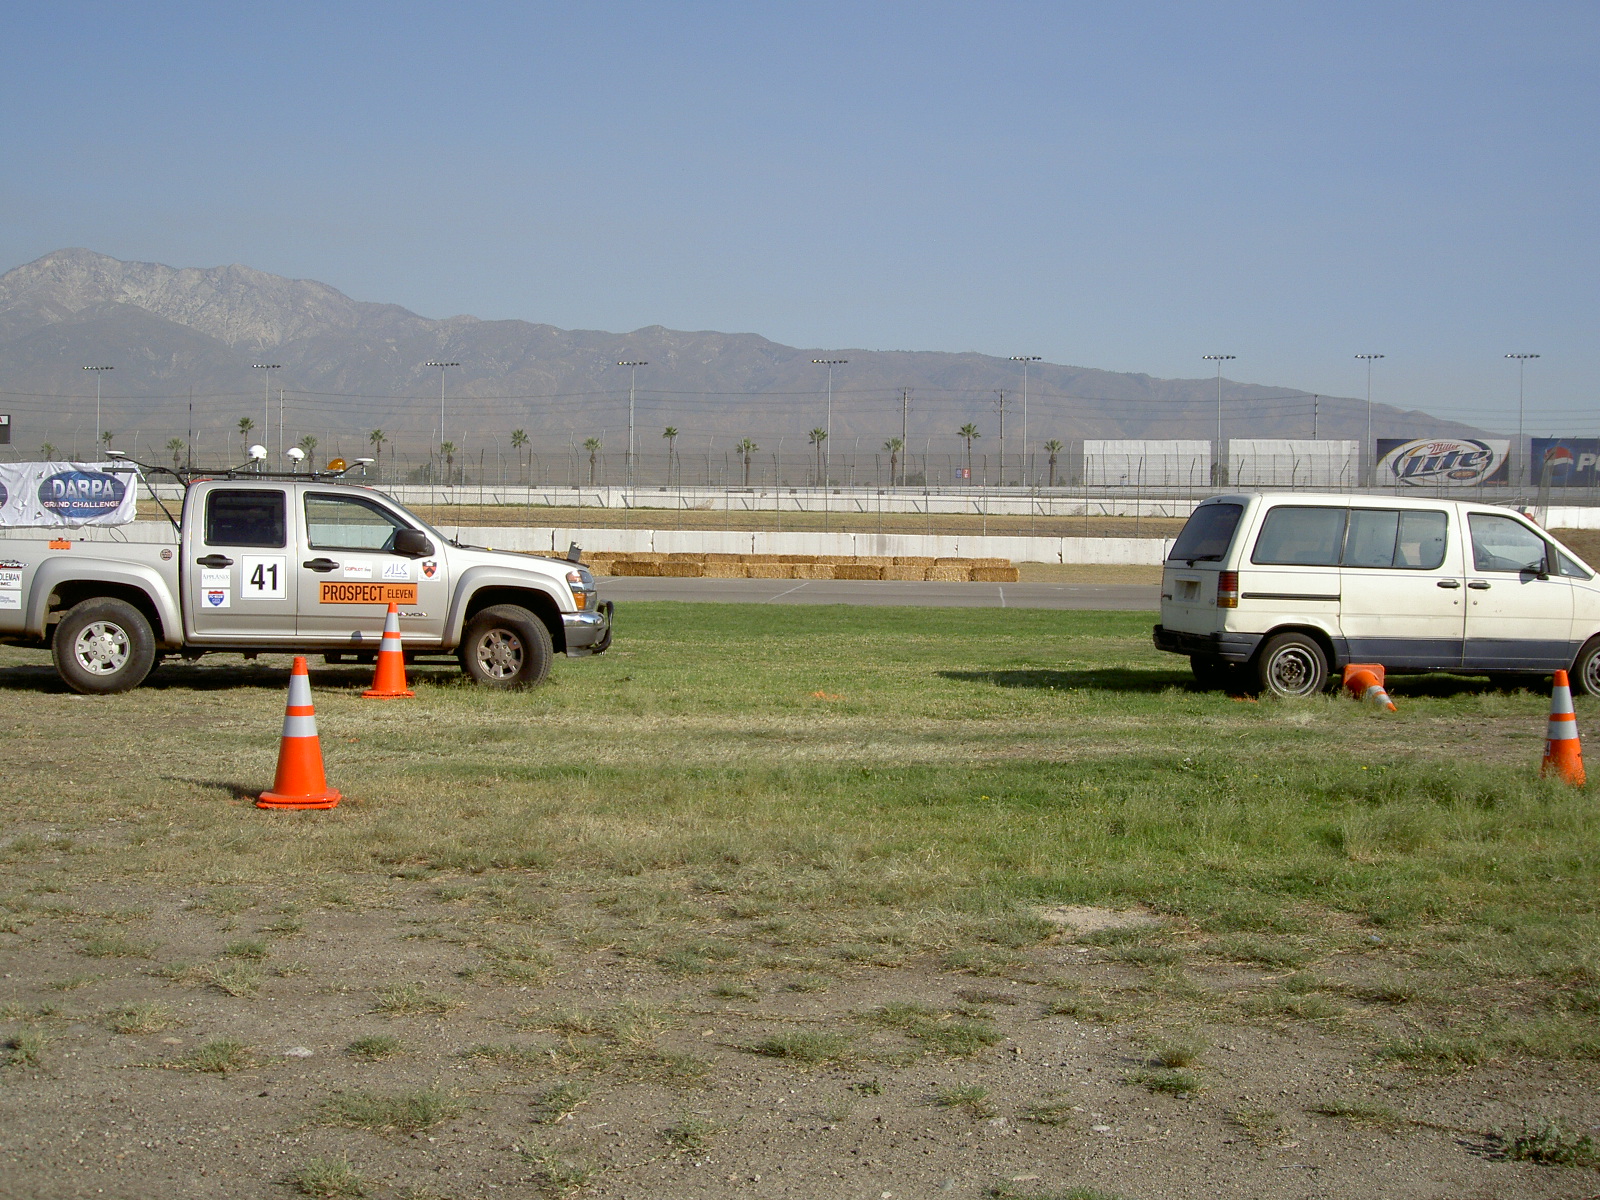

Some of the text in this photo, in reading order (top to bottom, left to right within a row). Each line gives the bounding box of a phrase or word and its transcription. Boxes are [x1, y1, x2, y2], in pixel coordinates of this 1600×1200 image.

[1427, 442, 1461, 455] Miller
[52, 479, 115, 499] DARPA
[72, 500, 120, 508] CHALLENGE
[250, 563, 278, 591] 41
[322, 585, 413, 601] PROSPECT ELEVEN
